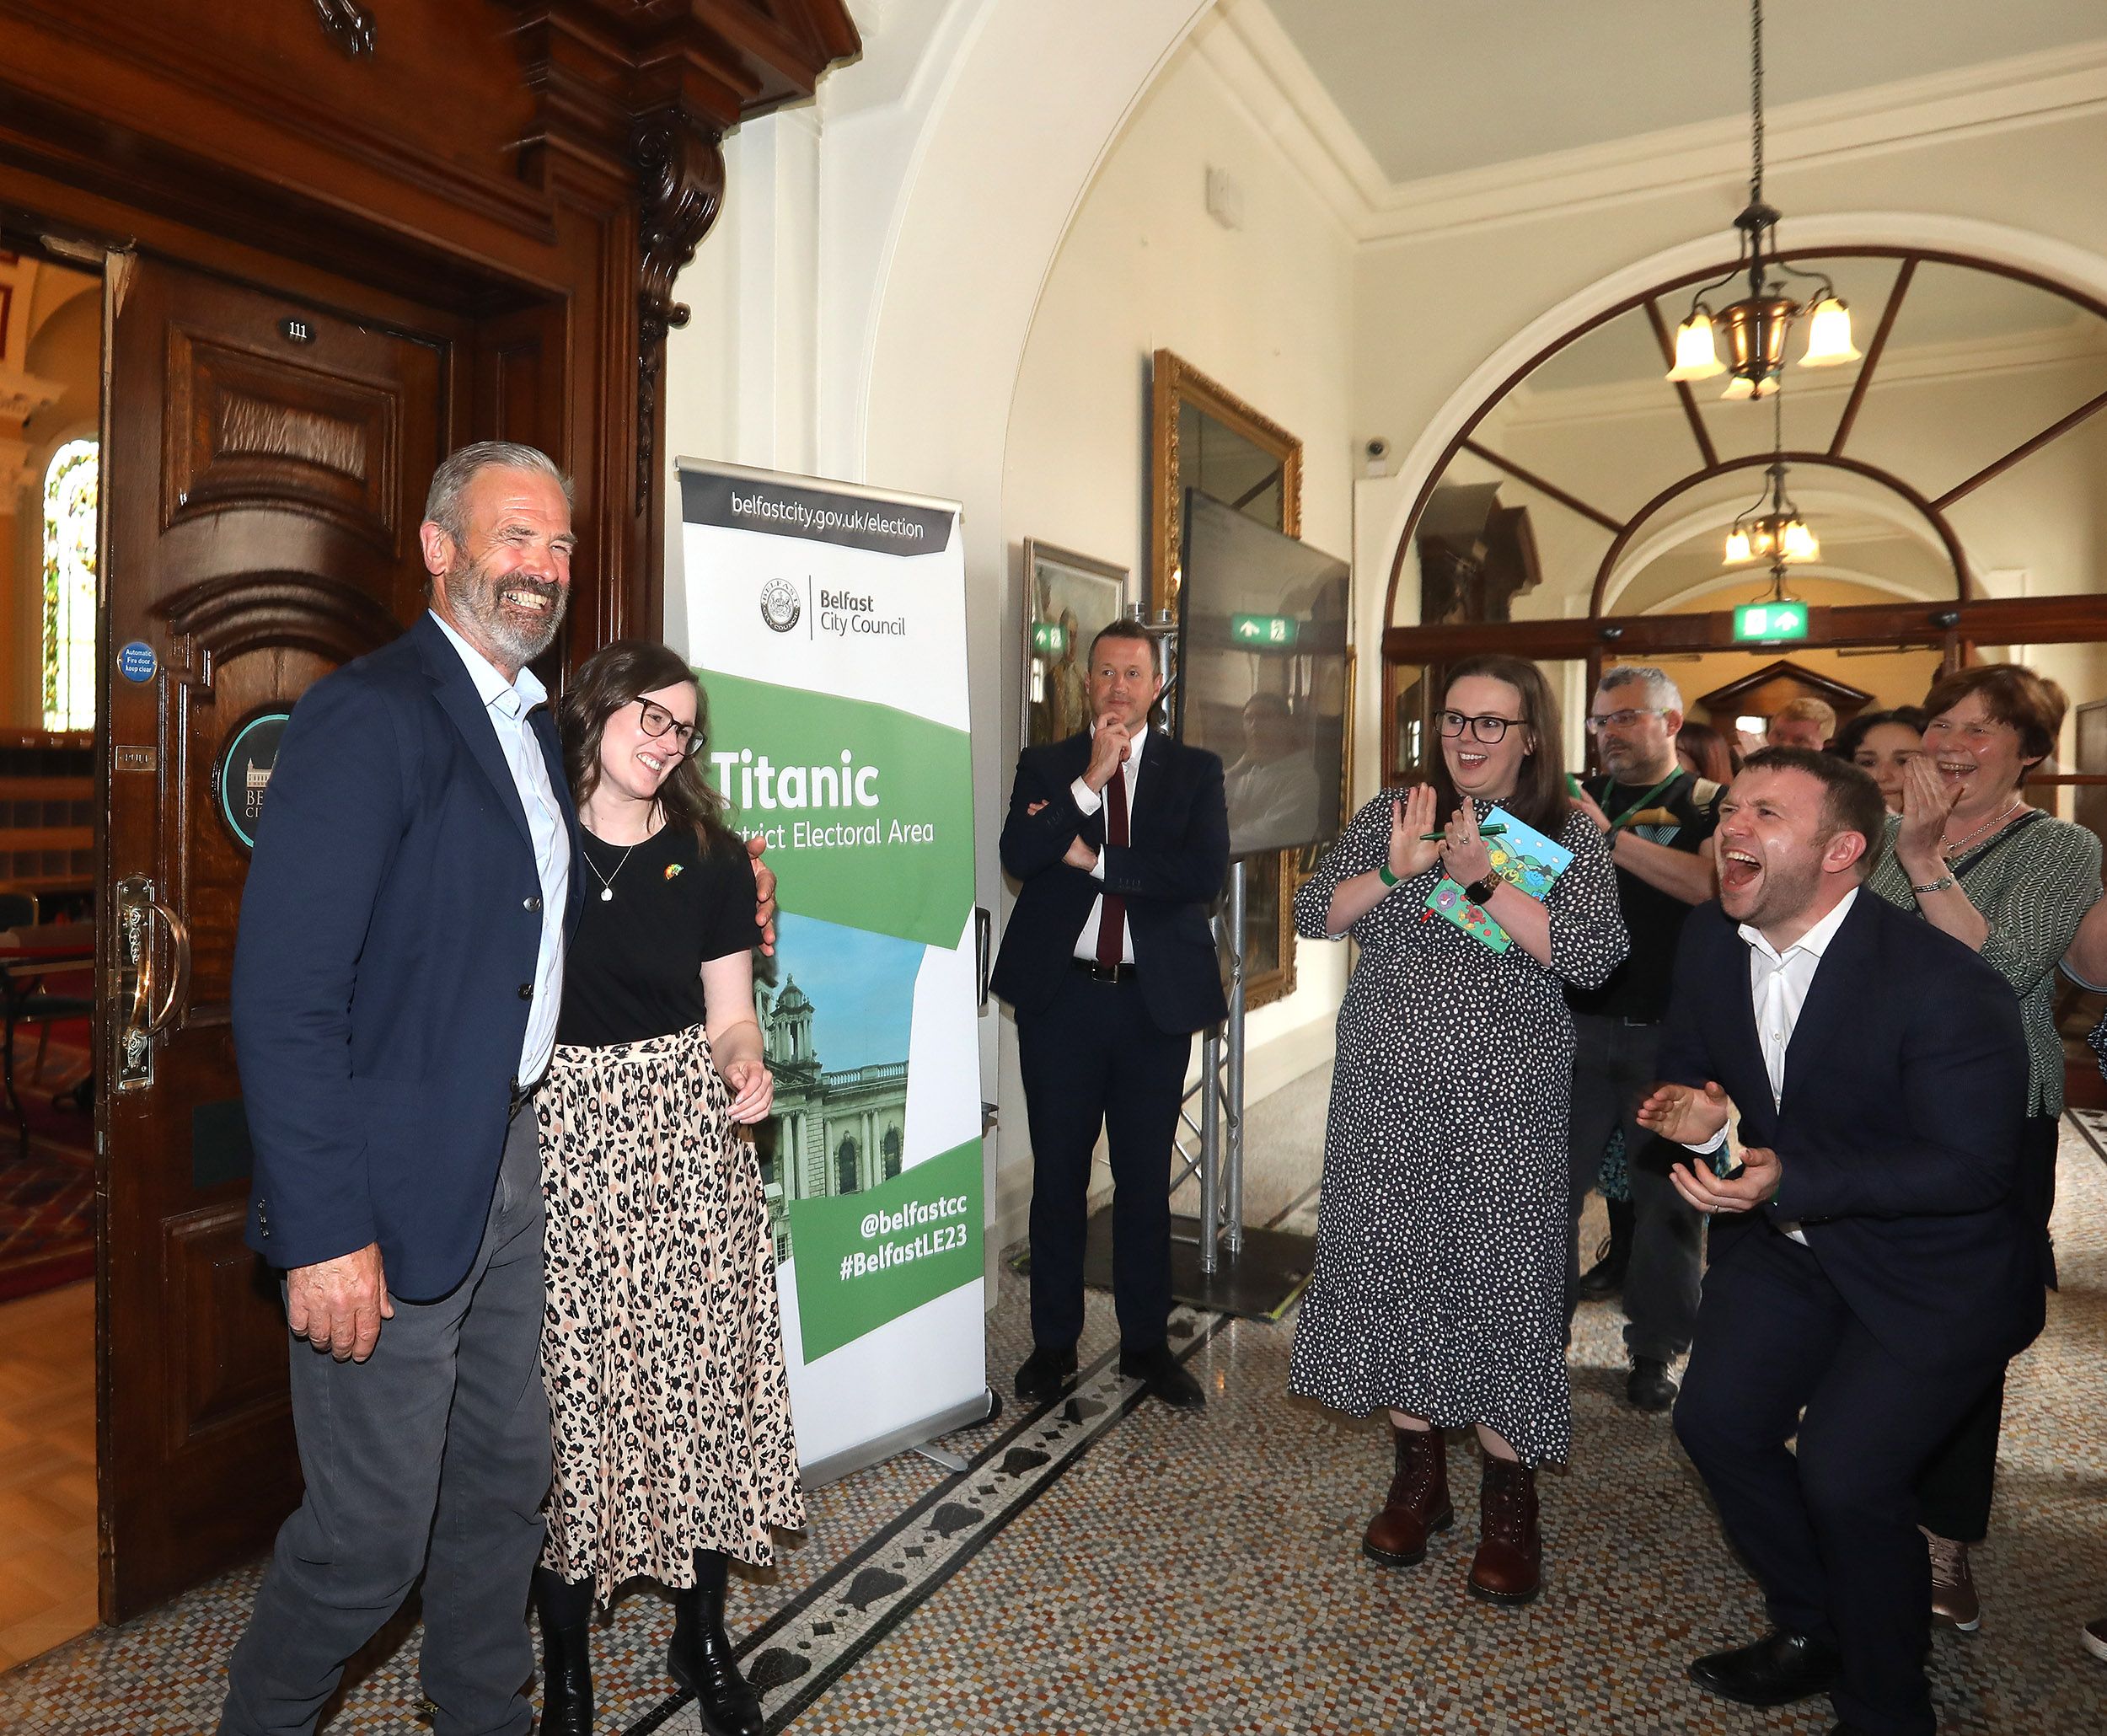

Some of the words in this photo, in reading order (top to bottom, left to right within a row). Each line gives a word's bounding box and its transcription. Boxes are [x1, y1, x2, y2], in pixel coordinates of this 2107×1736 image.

[289, 321, 308, 339] 111
[732, 491, 925, 539] belfastcity.gov.uk/election
[820, 589, 874, 613] Belfast
[821, 611, 848, 637] City
[851, 613, 906, 635] Council
[126, 648, 153, 657] Automatic
[125, 664, 138, 672] keep
[710, 747, 880, 810] Titanic
[245, 806, 263, 818] CI
[793, 817, 882, 849] Electoral
[887, 817, 935, 844] Area
[860, 1195, 968, 1239] @belfastcc
[839, 1222, 968, 1281] #BelfastLE23
